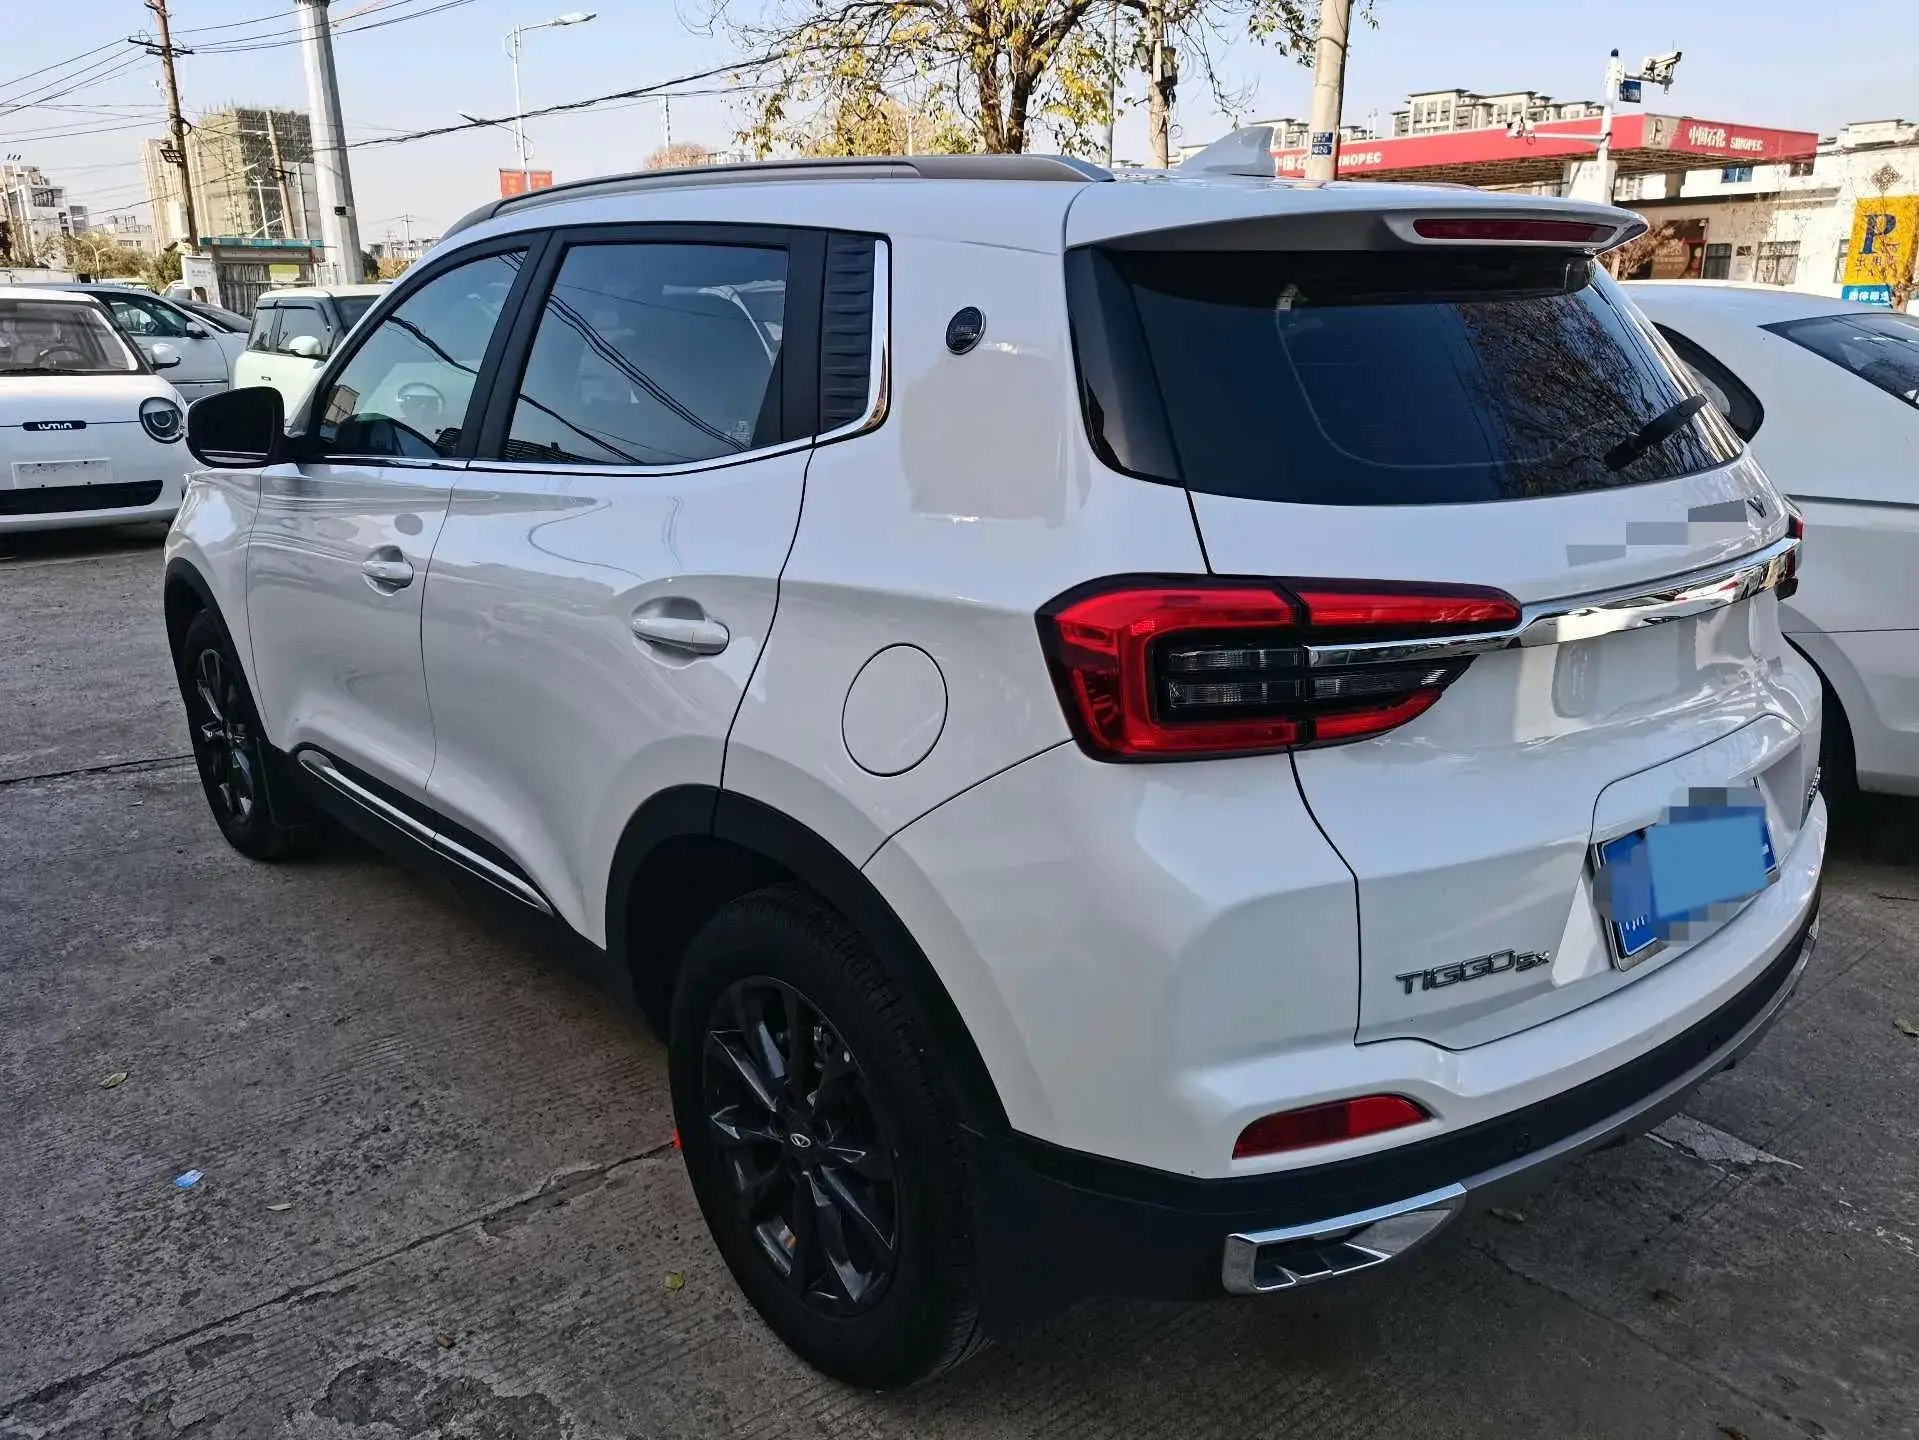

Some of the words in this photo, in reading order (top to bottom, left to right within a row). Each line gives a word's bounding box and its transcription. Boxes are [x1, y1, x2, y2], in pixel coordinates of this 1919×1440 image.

[1688, 126, 1726, 148] 中国石化
[1729, 136, 1763, 151] SINOPEC
[1337, 152, 1382, 168] INOPEC
[1859, 213, 1896, 254] P
